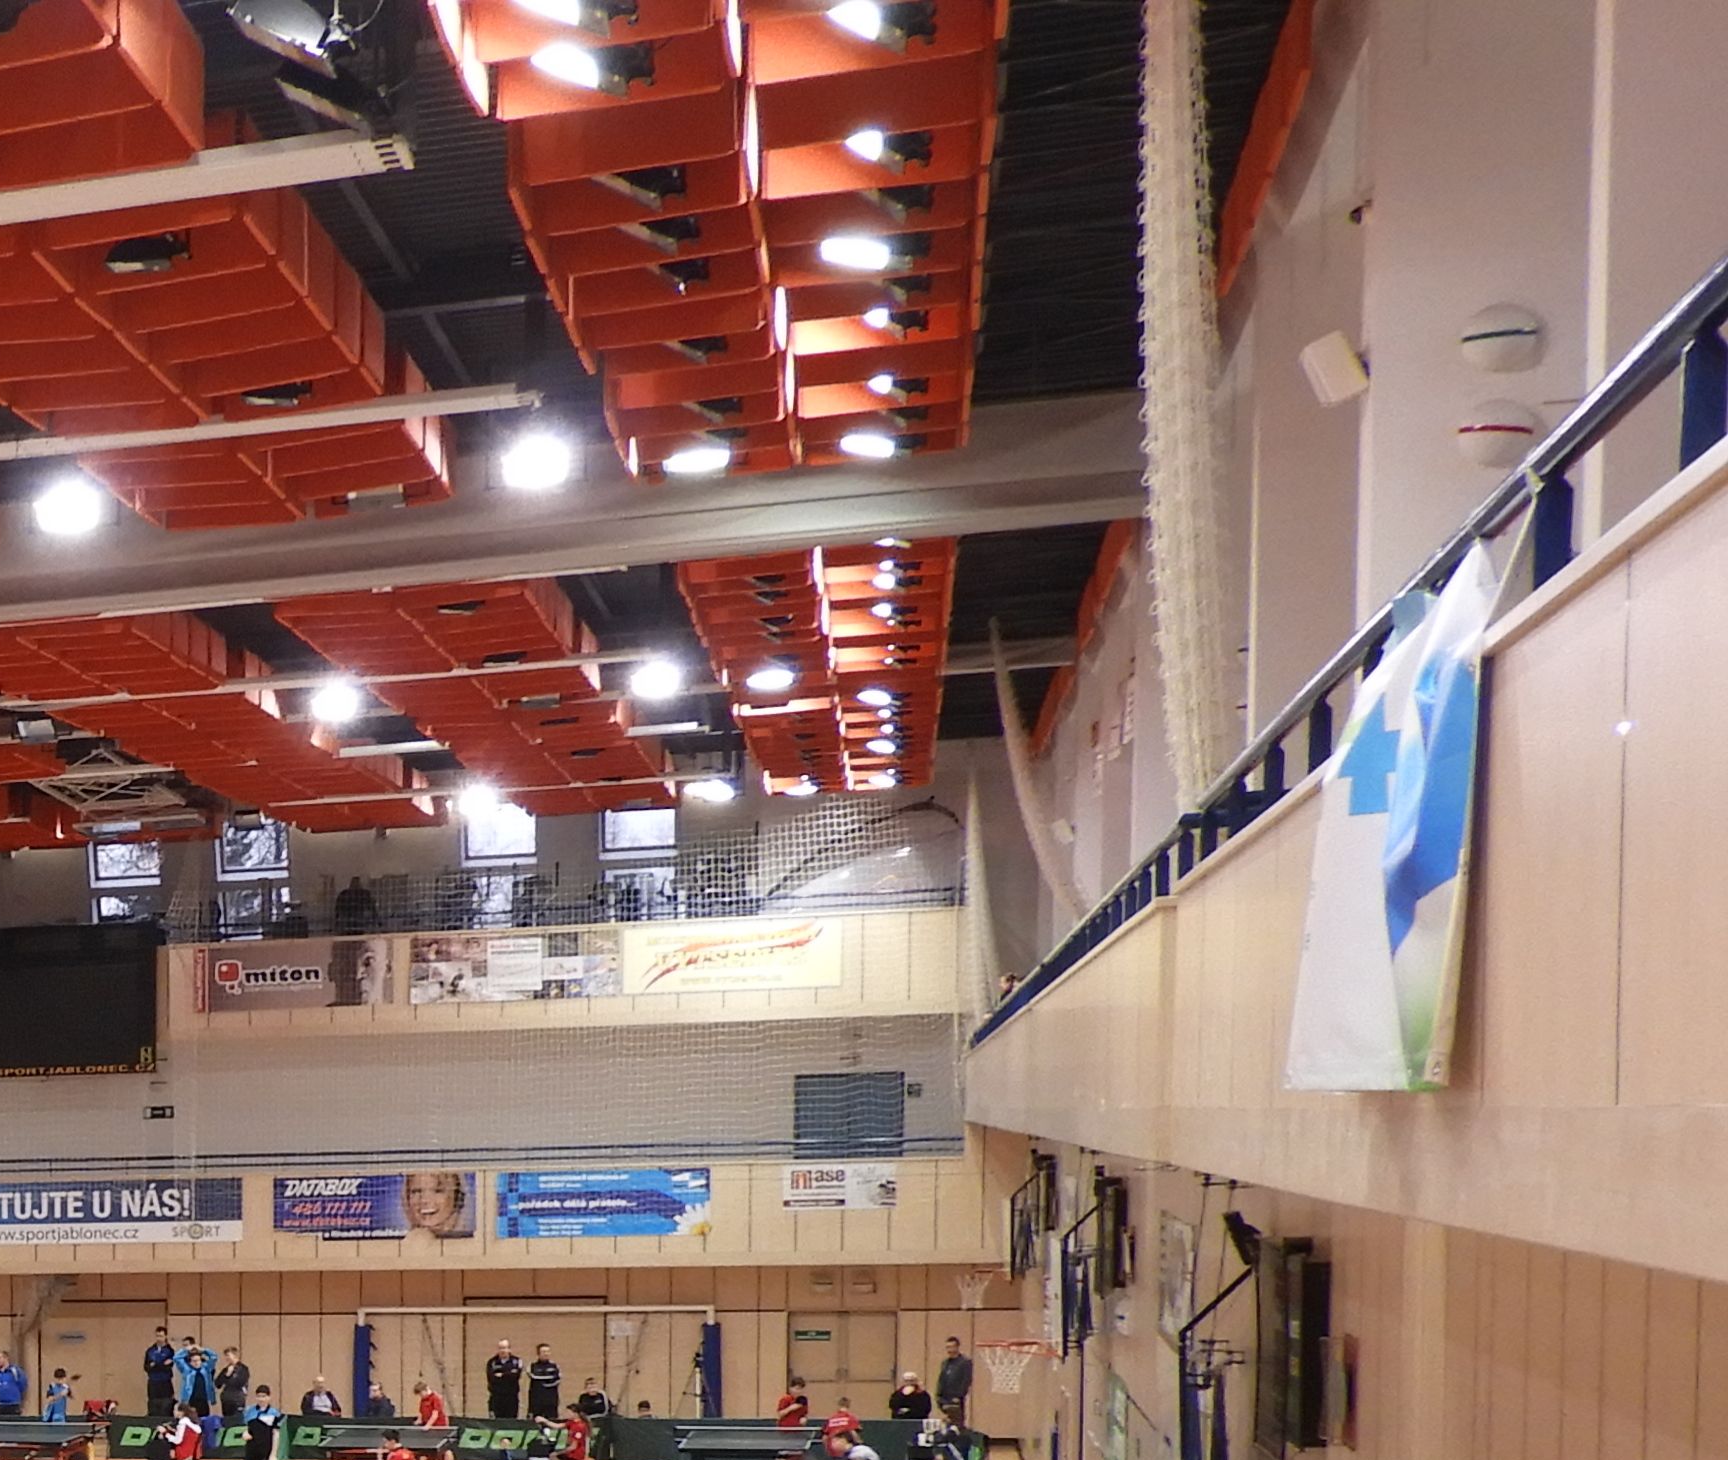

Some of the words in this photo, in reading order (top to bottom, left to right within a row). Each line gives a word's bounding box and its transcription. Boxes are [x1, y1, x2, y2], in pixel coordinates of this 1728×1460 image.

[245, 967, 321, 984] miton
[284, 1177, 363, 1197] DATABOX
[92, 1190, 112, 1219] U
[120, 1182, 192, 1218] NÁS!
